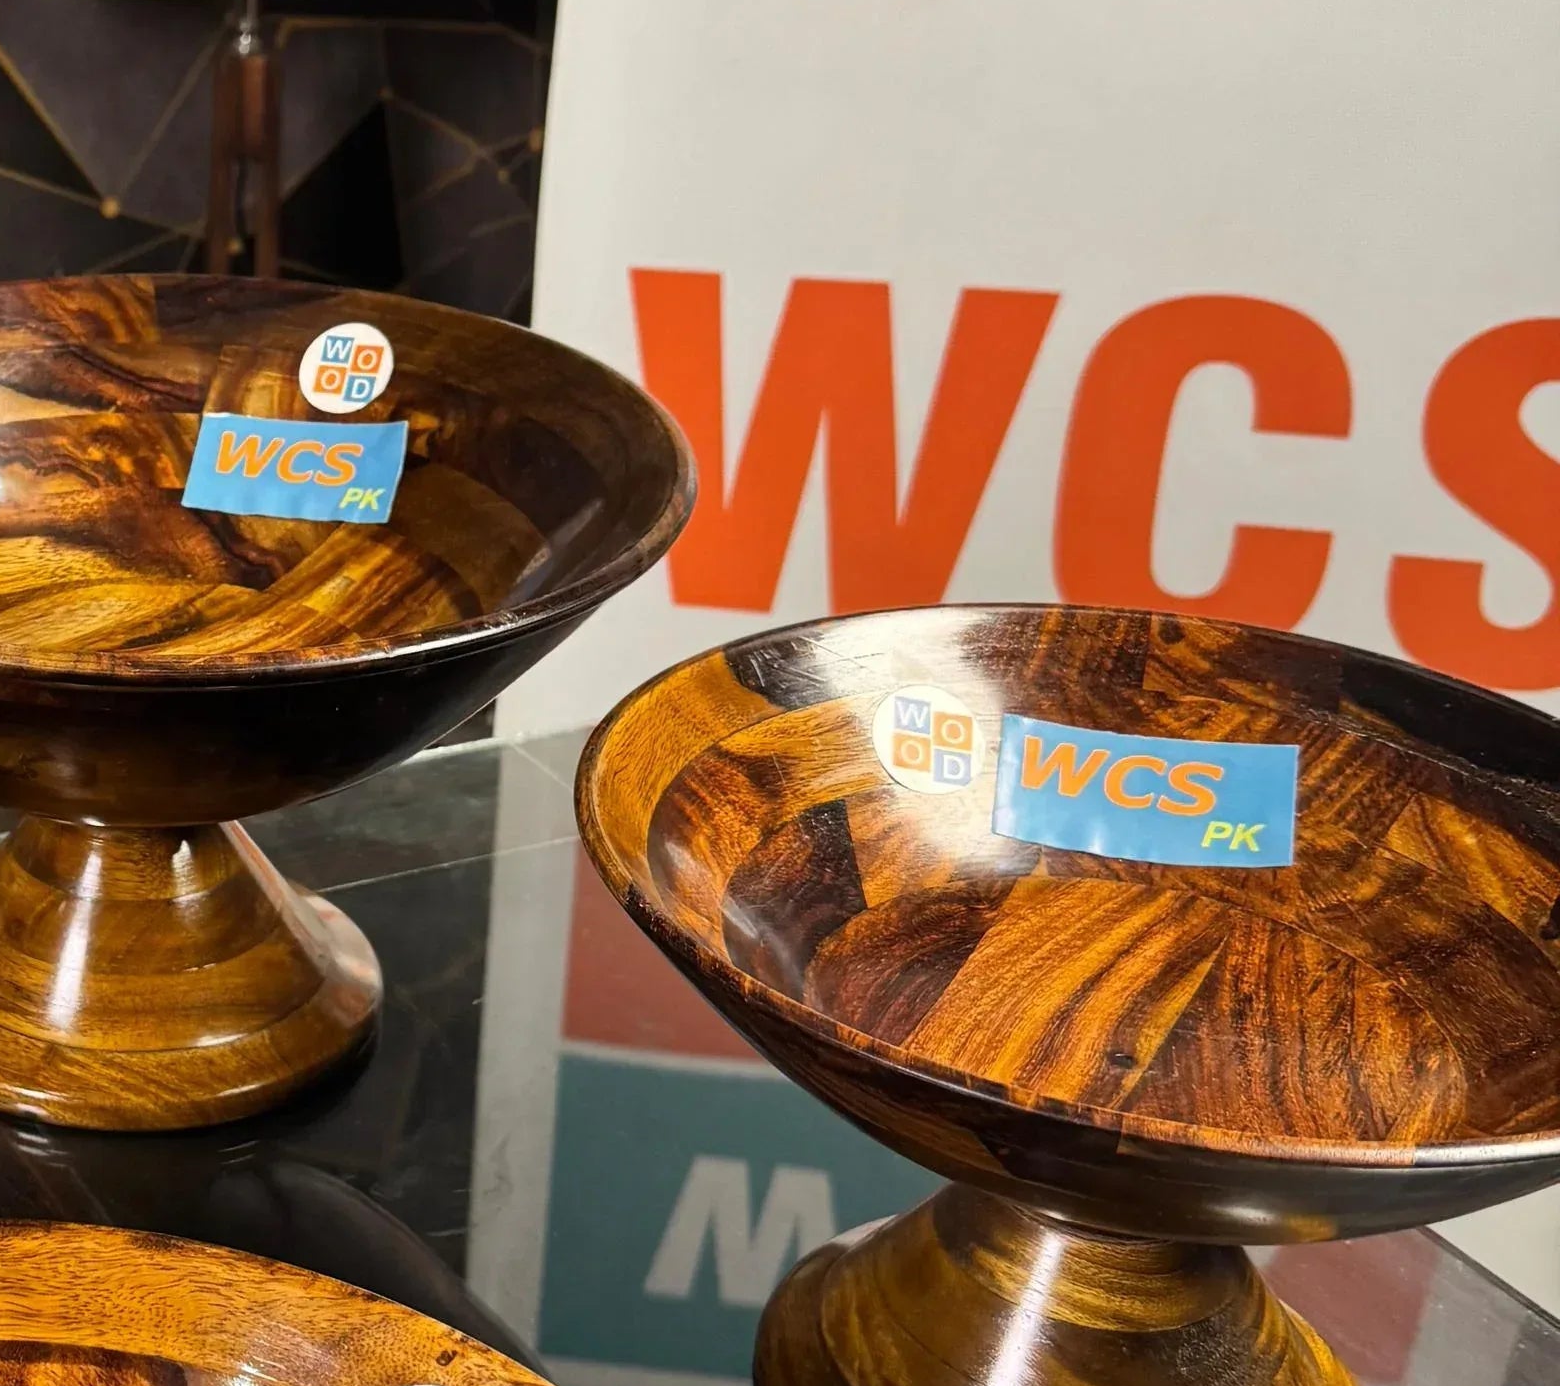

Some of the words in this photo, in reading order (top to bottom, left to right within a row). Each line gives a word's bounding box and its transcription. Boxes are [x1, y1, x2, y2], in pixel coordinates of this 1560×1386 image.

[215, 430, 364, 487] WCS
[339, 487, 386, 511] PK
[1020, 734, 1225, 816] WCS
[1200, 820, 1266, 852] PK
